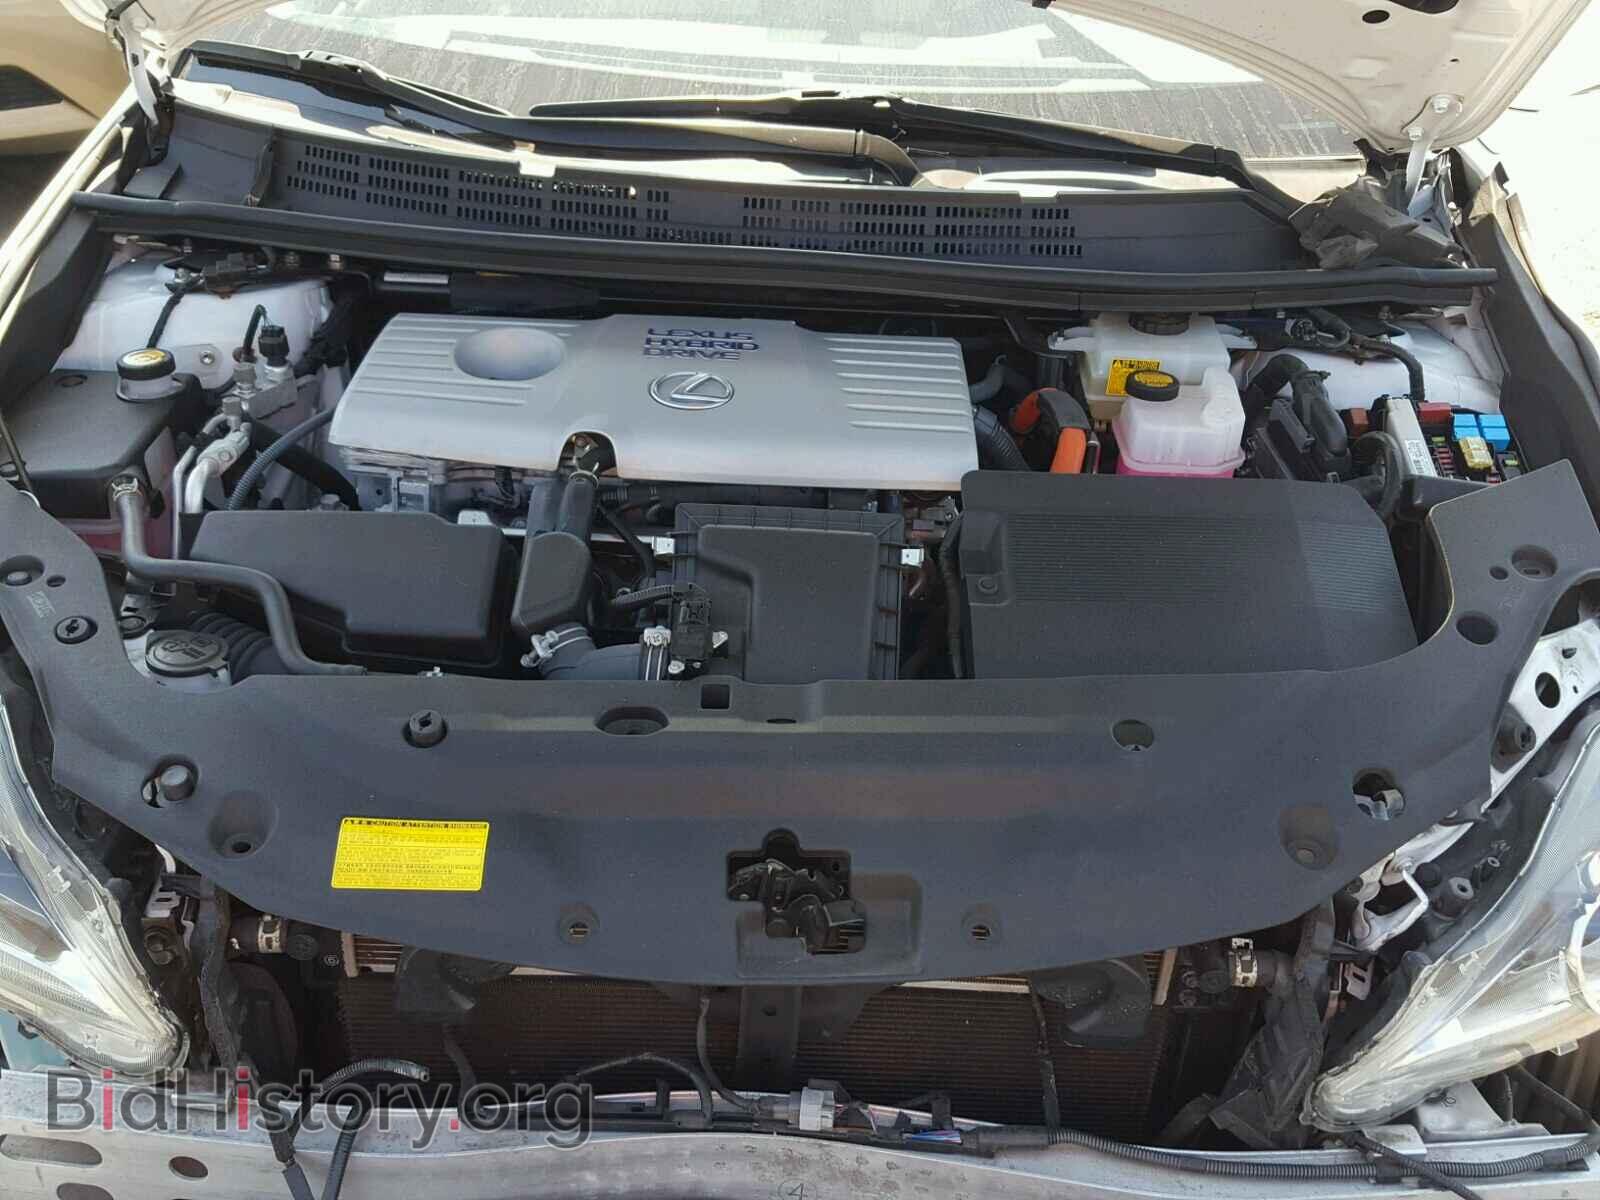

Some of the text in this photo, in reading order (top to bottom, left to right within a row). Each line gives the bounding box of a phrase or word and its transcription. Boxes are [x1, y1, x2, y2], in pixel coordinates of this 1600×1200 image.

[647, 328, 754, 341] LEXUS
[645, 338, 760, 351] HYBRID
[643, 348, 741, 360] DRIVE
